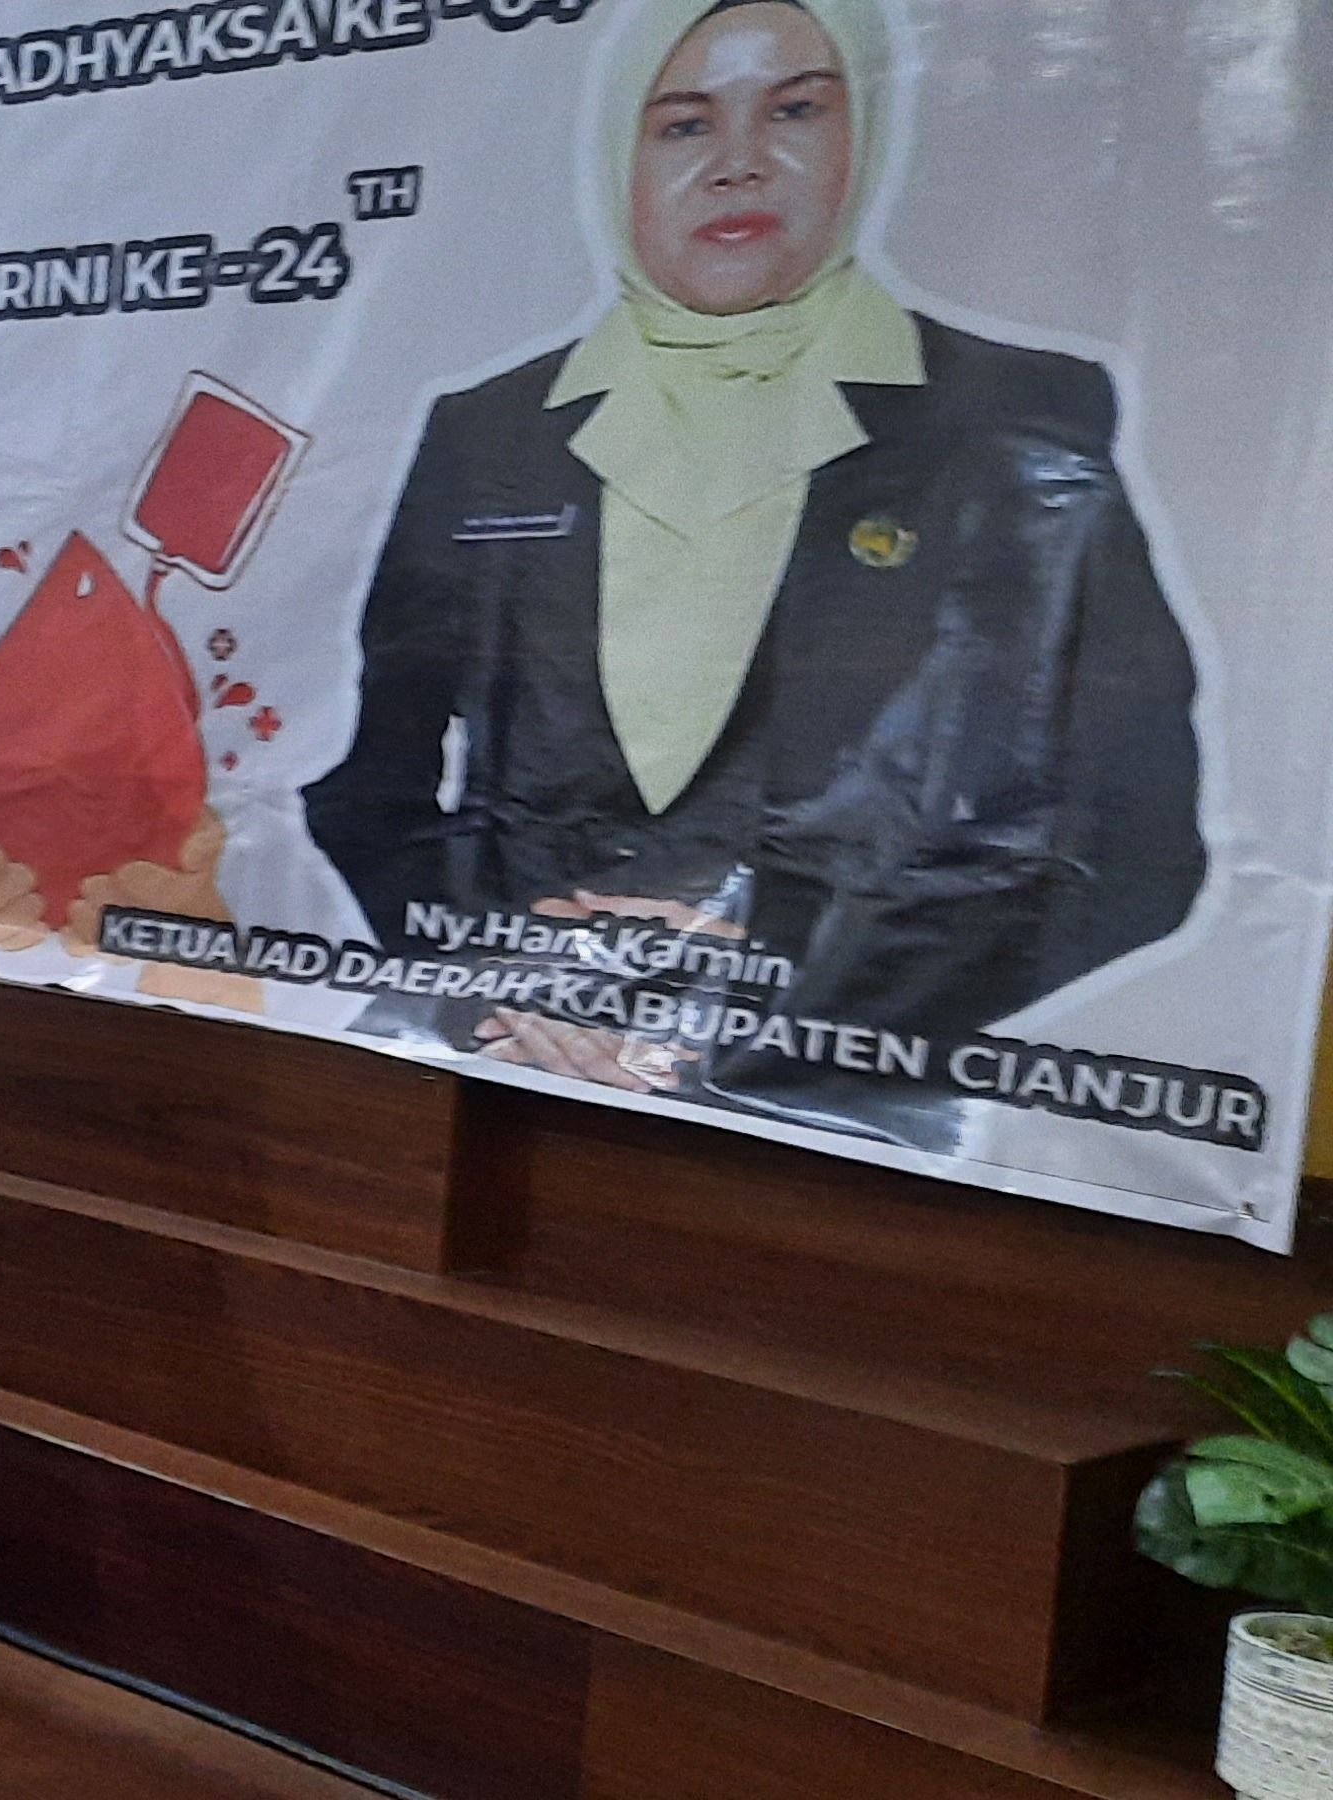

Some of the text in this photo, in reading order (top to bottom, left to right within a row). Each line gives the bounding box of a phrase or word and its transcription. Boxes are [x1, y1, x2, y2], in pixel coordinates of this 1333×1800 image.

[334, 0, 425, 44] KE
[121, 246, 207, 303] KE
[257, 233, 344, 293] 24
[351, 172, 418, 213] TH
[102, 912, 1265, 1137] KETUA IAD DAERAH KABUPATEN CIANJUR
